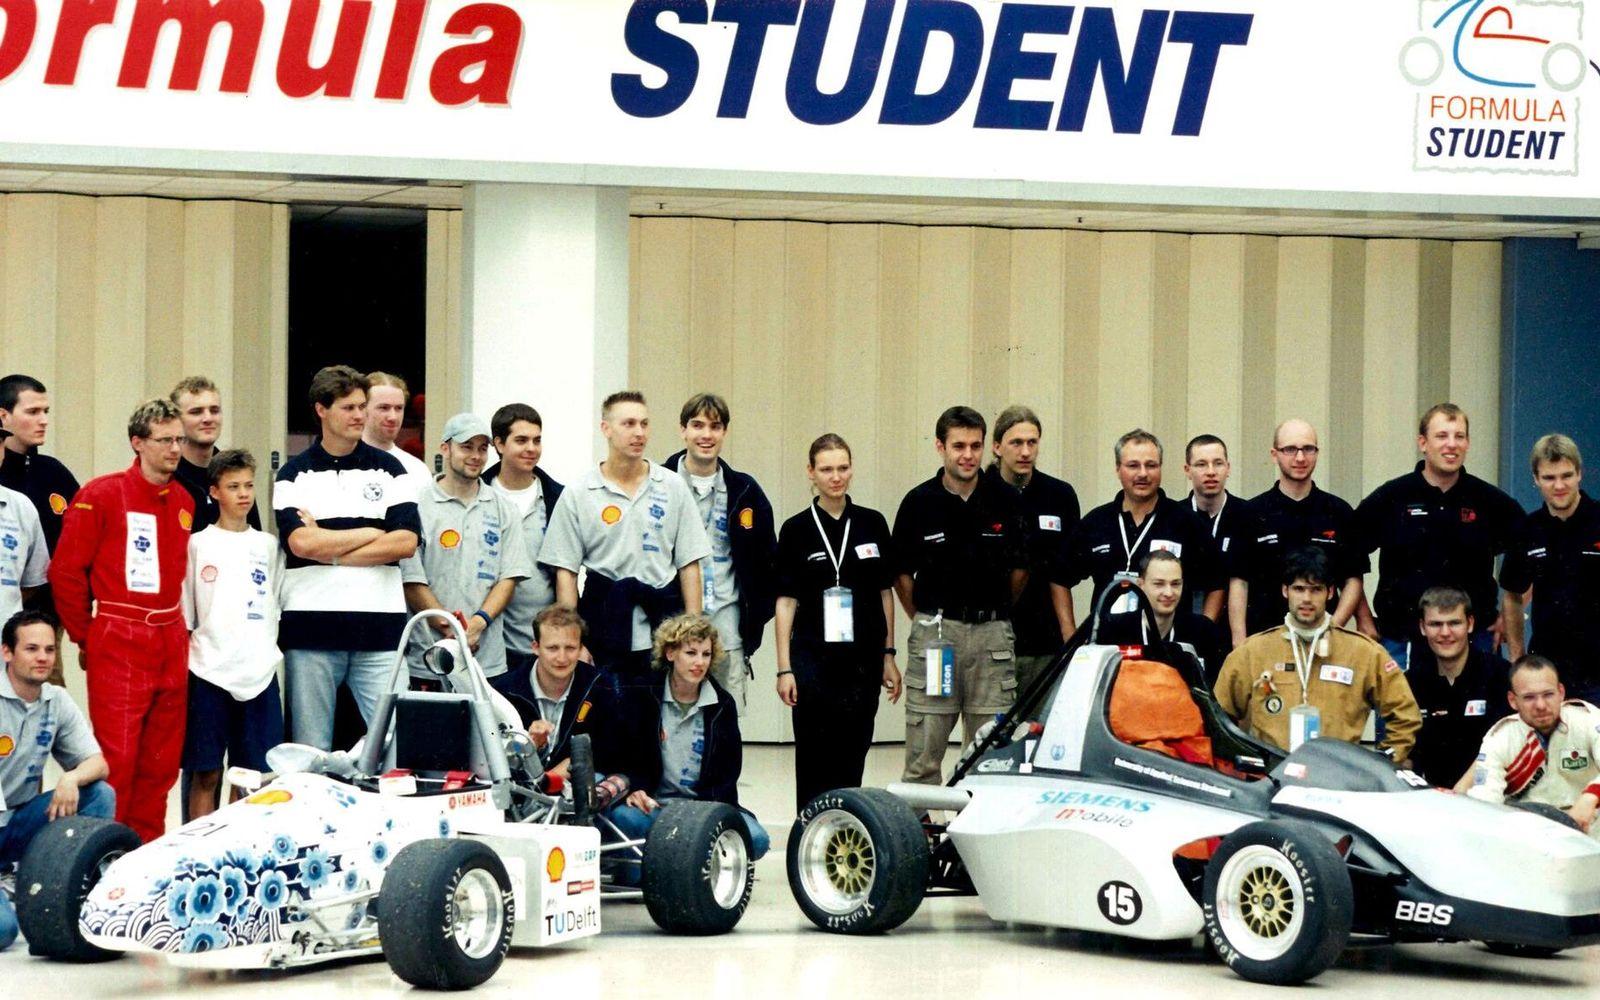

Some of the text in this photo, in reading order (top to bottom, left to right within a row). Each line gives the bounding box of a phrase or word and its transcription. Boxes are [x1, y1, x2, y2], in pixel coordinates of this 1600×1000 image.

[610, 0, 1255, 137] STUDENT
[1429, 95, 1566, 122] FORMULA
[1426, 126, 1566, 160] STUDENT
[458, 791, 486, 807] YAMAHA
[1036, 790, 1156, 812] SIEMENS
[1104, 884, 1136, 921] 15
[1395, 900, 1455, 926] BBS
